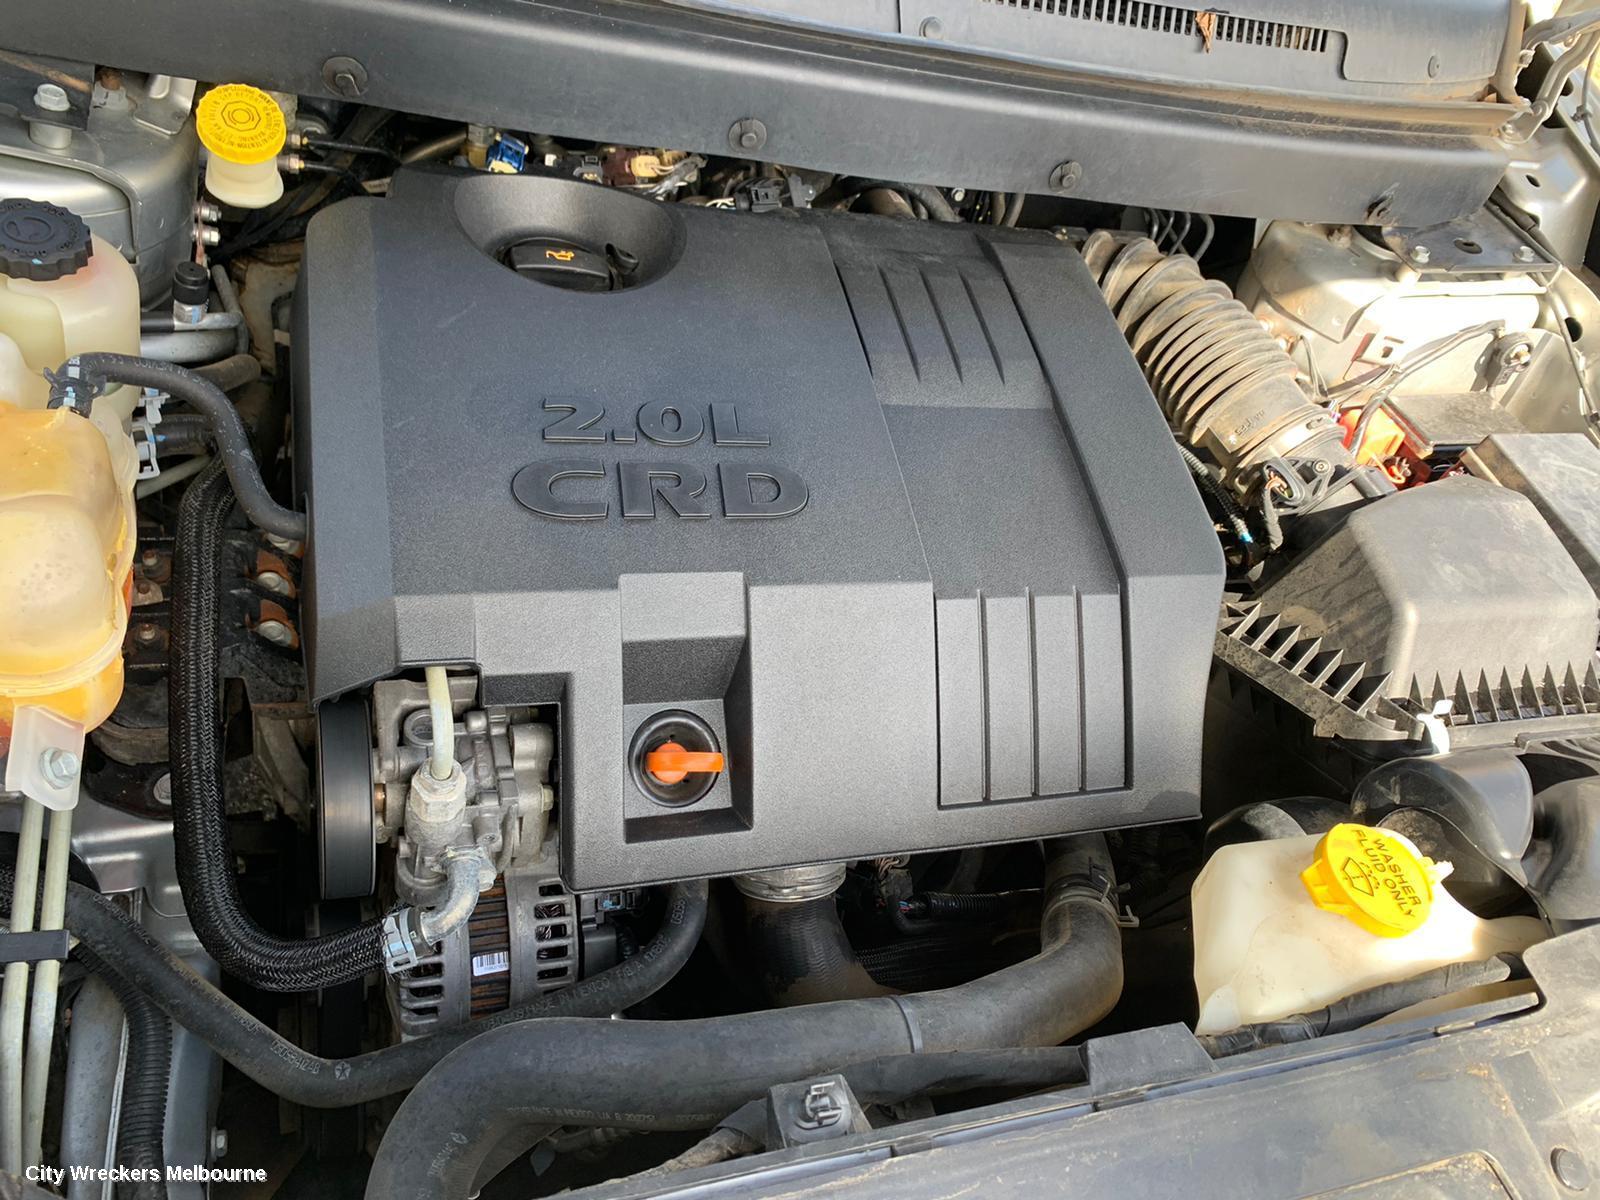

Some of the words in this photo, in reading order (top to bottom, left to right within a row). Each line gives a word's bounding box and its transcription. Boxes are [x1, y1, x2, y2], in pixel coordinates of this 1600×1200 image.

[541, 398, 771, 447] 2.0L
[510, 457, 810, 521] CRD
[1352, 829, 1386, 873] FLUID
[1383, 877, 1416, 918] ONLY
[1373, 838, 1422, 906] WASHER
